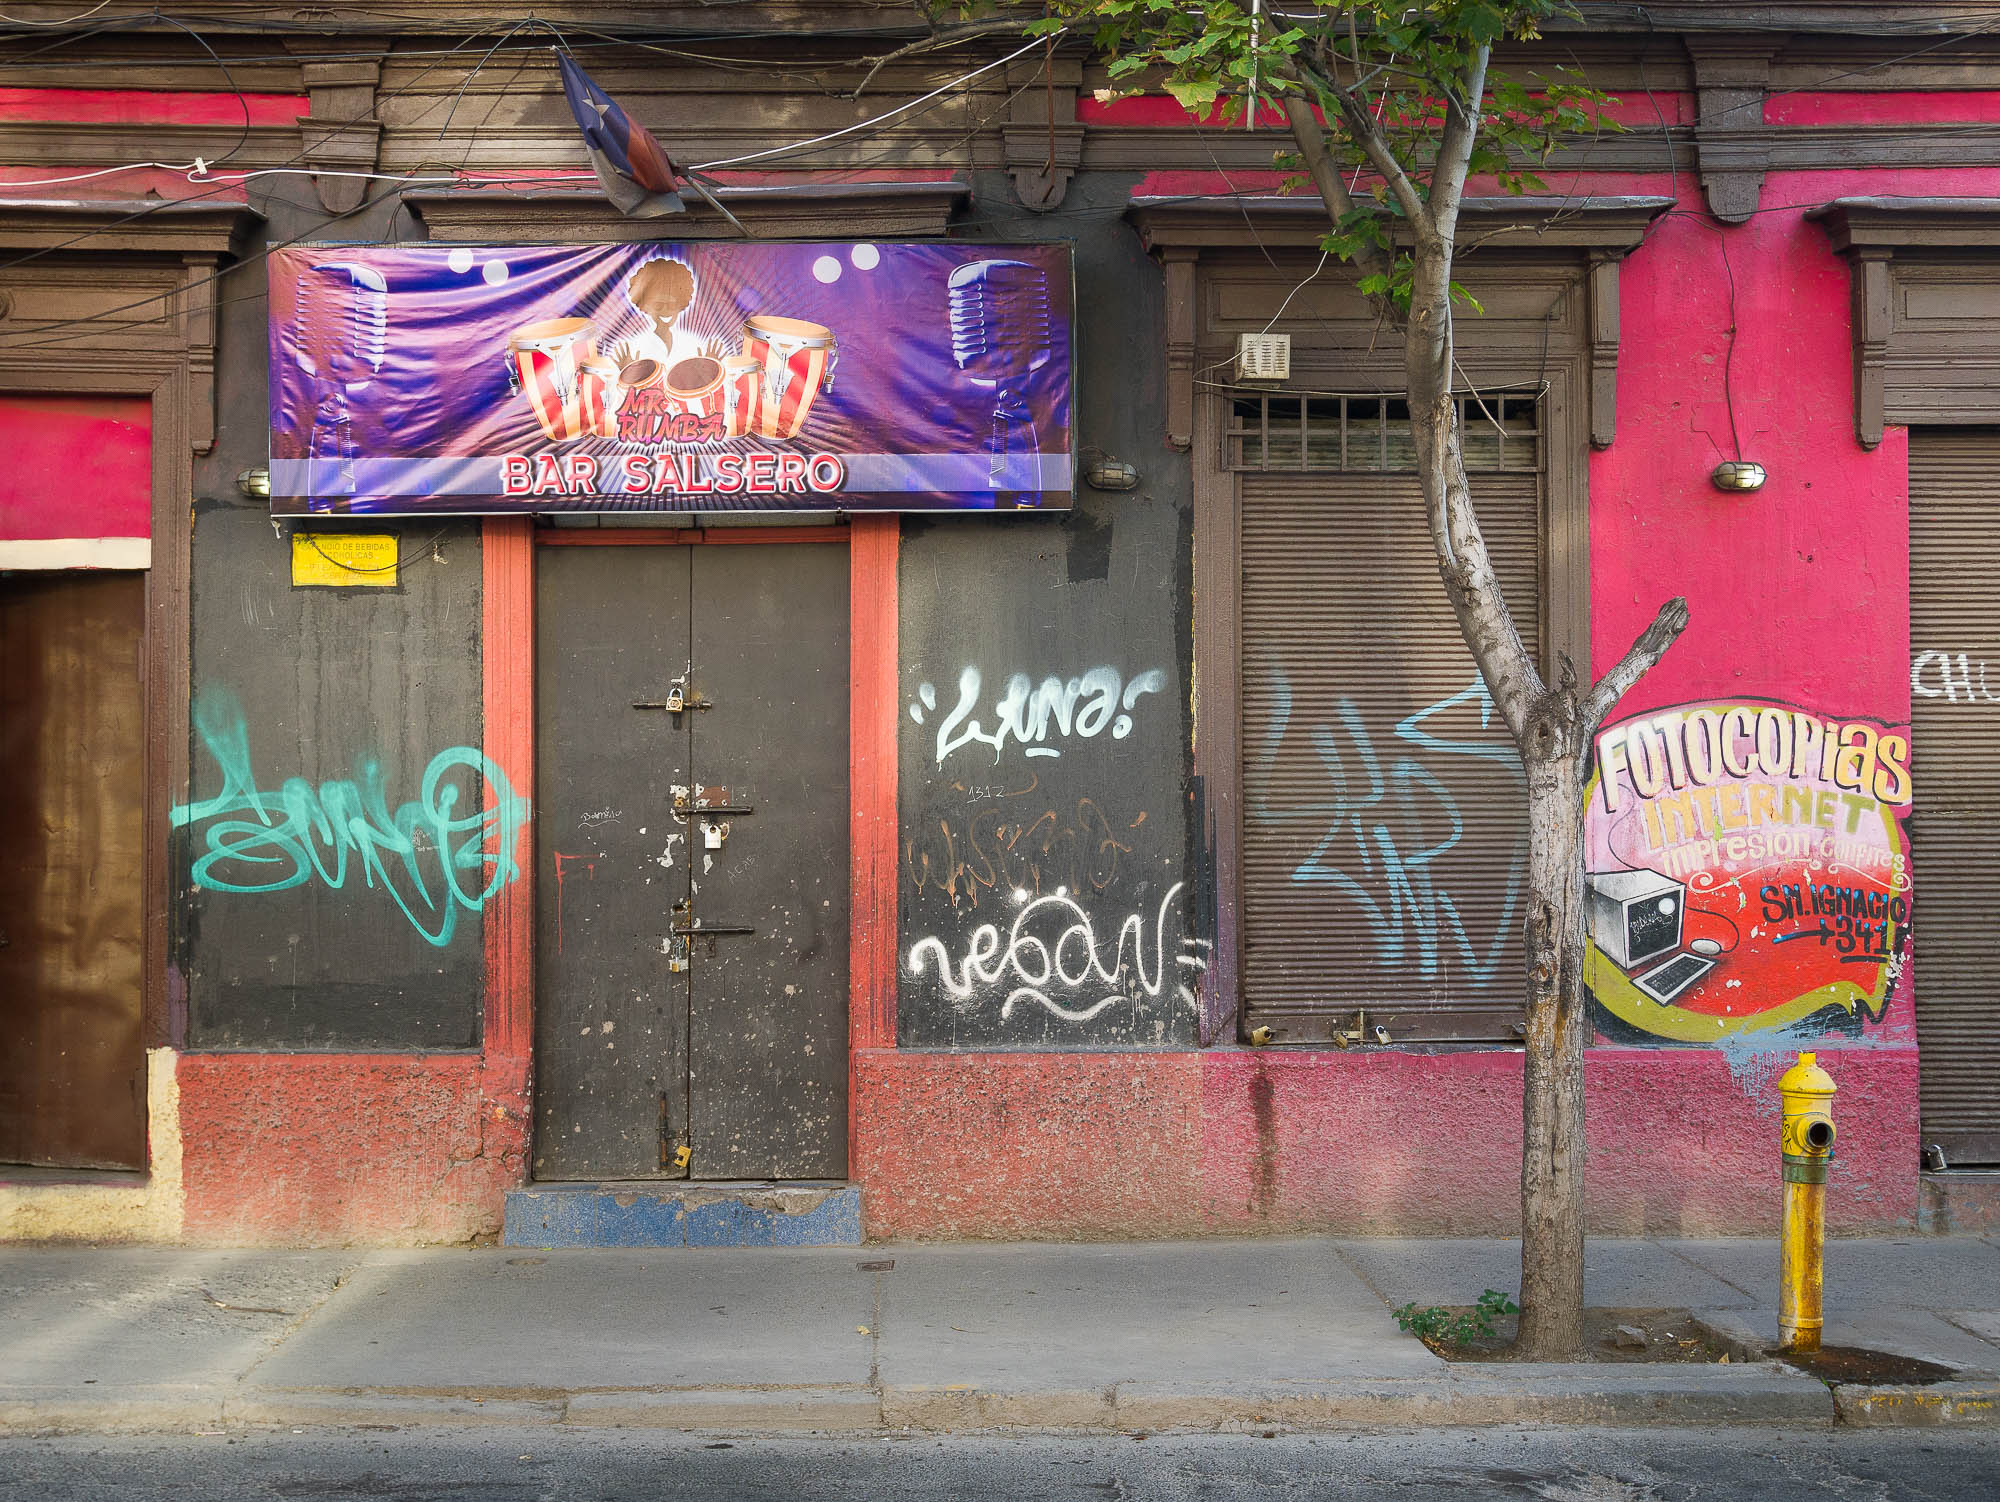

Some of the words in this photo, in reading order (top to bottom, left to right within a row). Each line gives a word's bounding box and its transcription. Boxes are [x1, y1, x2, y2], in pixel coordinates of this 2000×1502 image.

[616, 386, 665, 416] MR
[616, 412, 727, 446] RUMBA
[500, 452, 597, 495] BAR
[622, 452, 846, 495] SALSERO
[343, 543, 353, 551] DE
[356, 543, 390, 551] BEBIDAS
[1642, 782, 1876, 852] INTERNET
